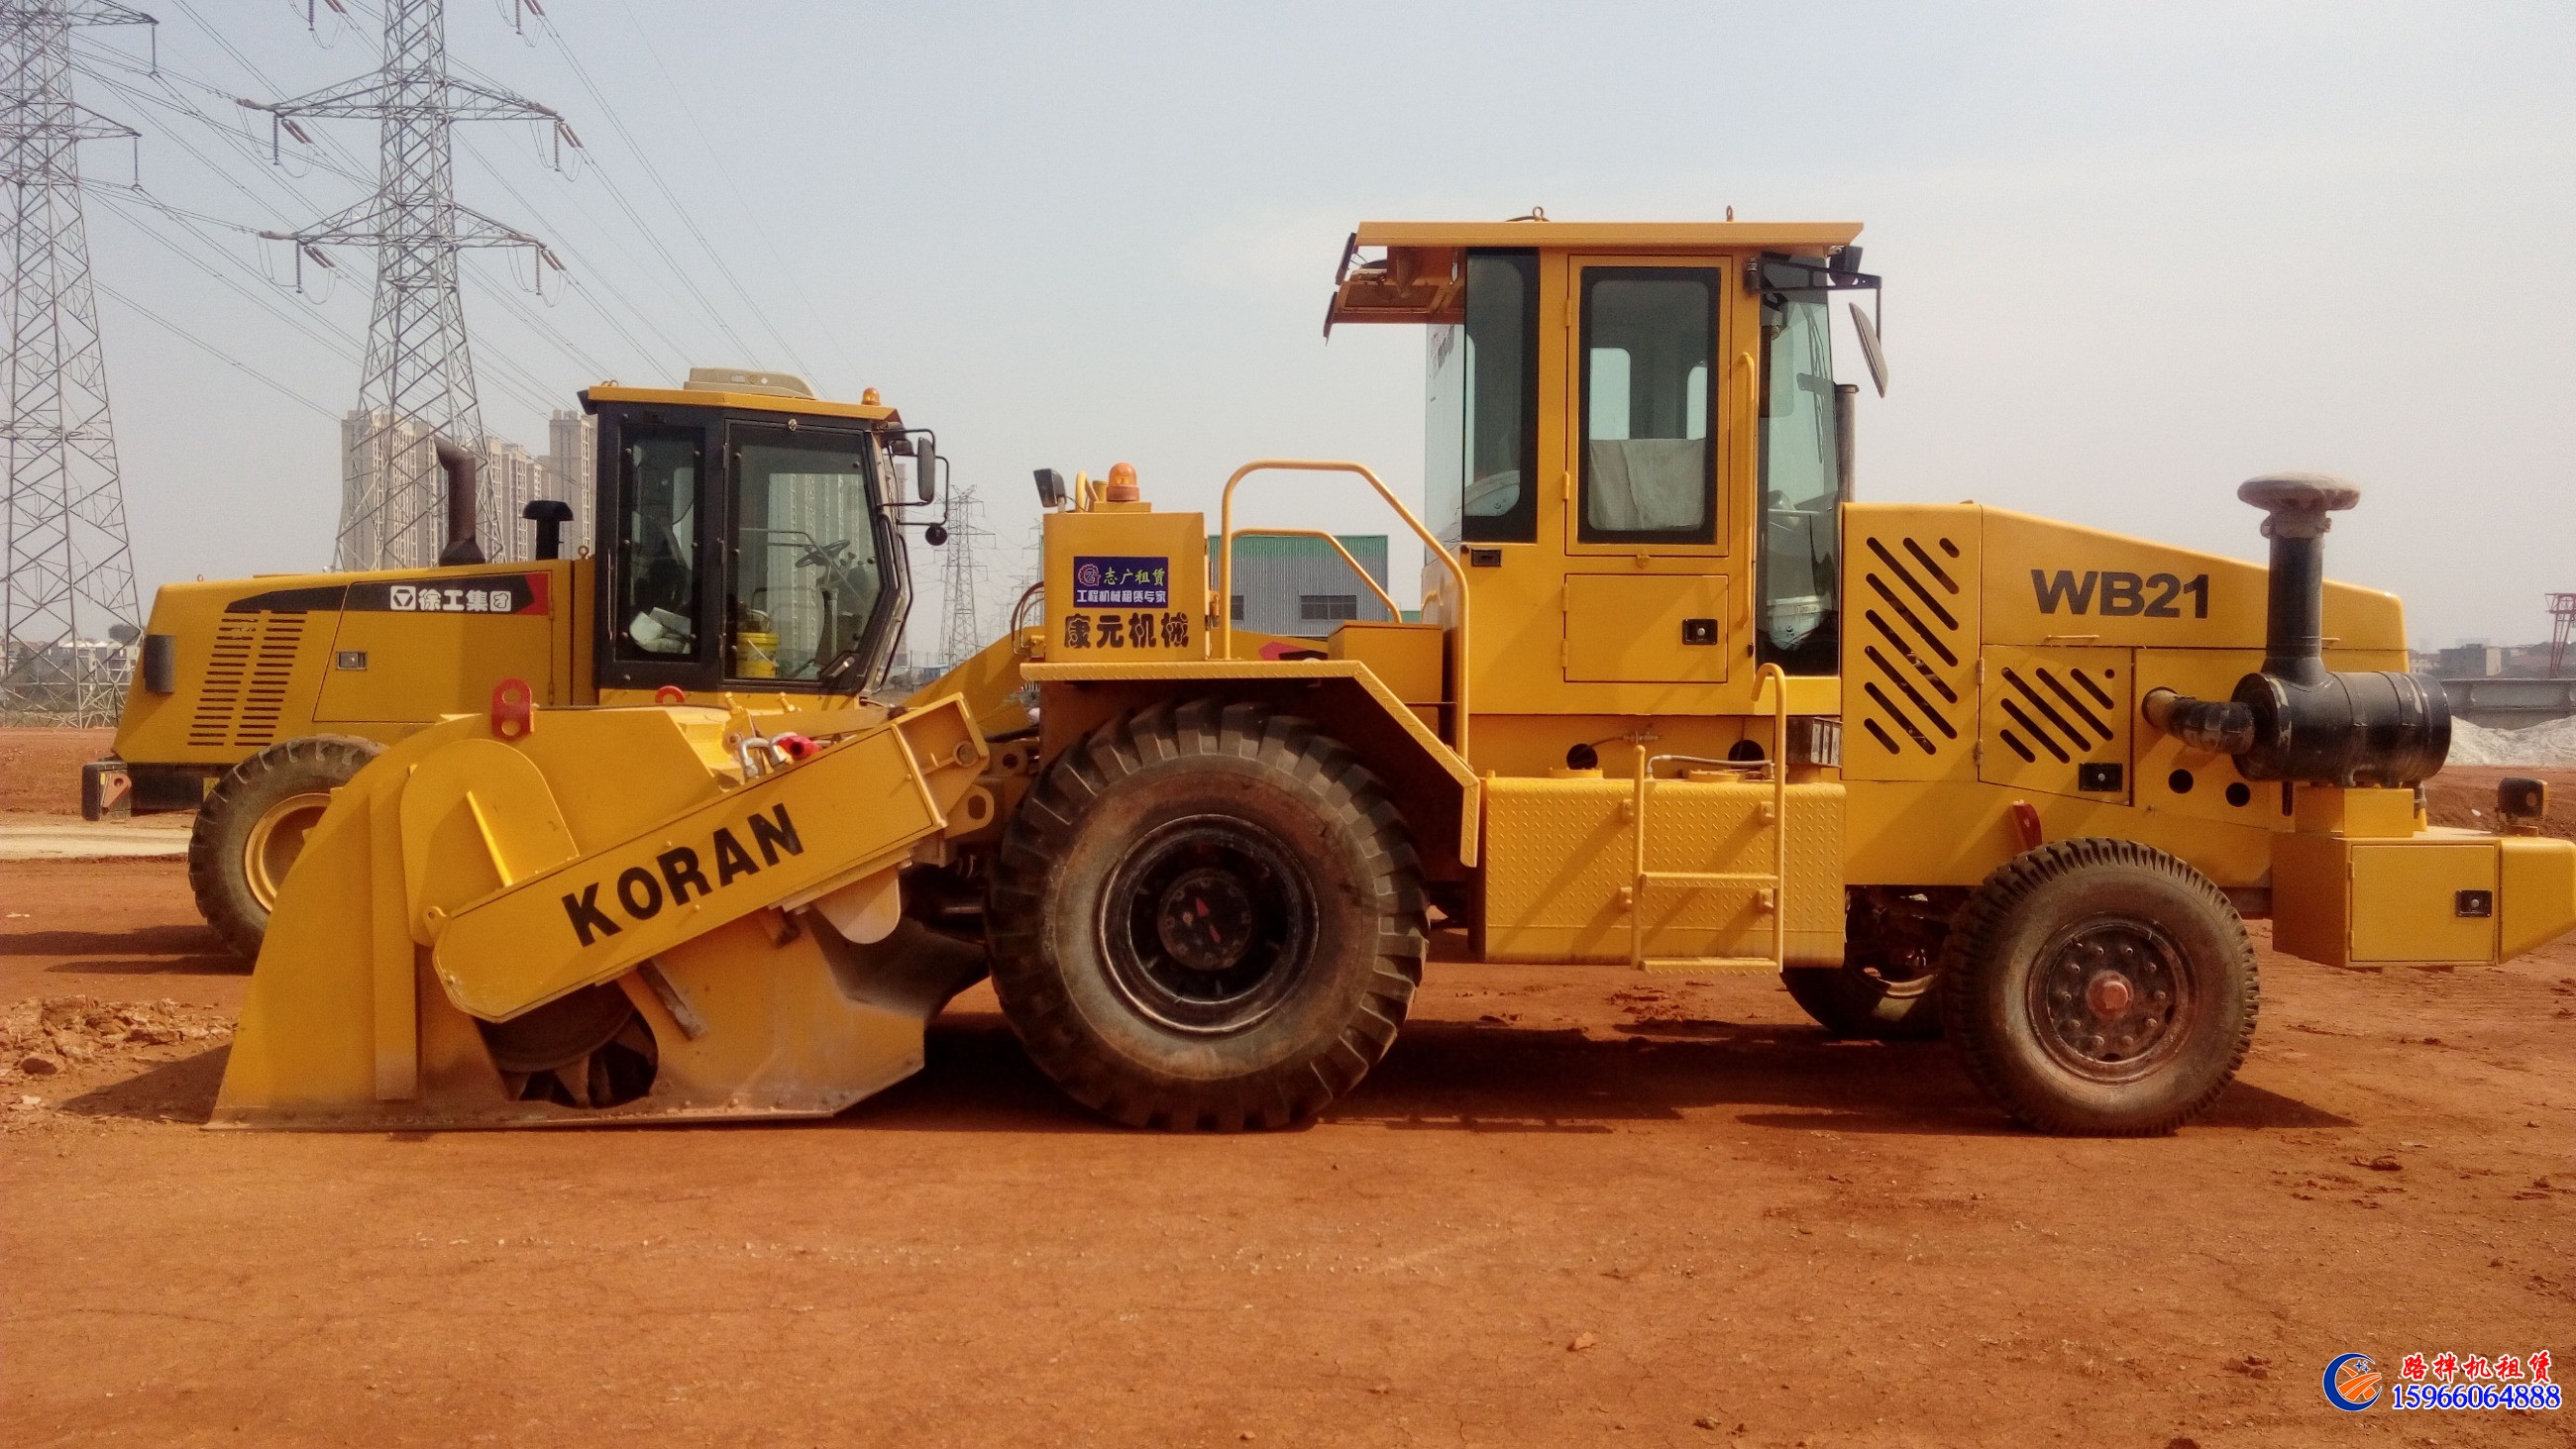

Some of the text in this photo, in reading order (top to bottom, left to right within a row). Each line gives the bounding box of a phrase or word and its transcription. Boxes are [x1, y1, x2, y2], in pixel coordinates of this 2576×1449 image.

[1104, 567, 1166, 586] 志广租赁
[418, 588, 512, 612] 徐工集团
[1077, 589, 1167, 603] 工程机械租赁专家
[2031, 569, 2209, 619] WB21
[1064, 612, 1189, 649] 康元机械
[561, 802, 805, 948] KORAN
